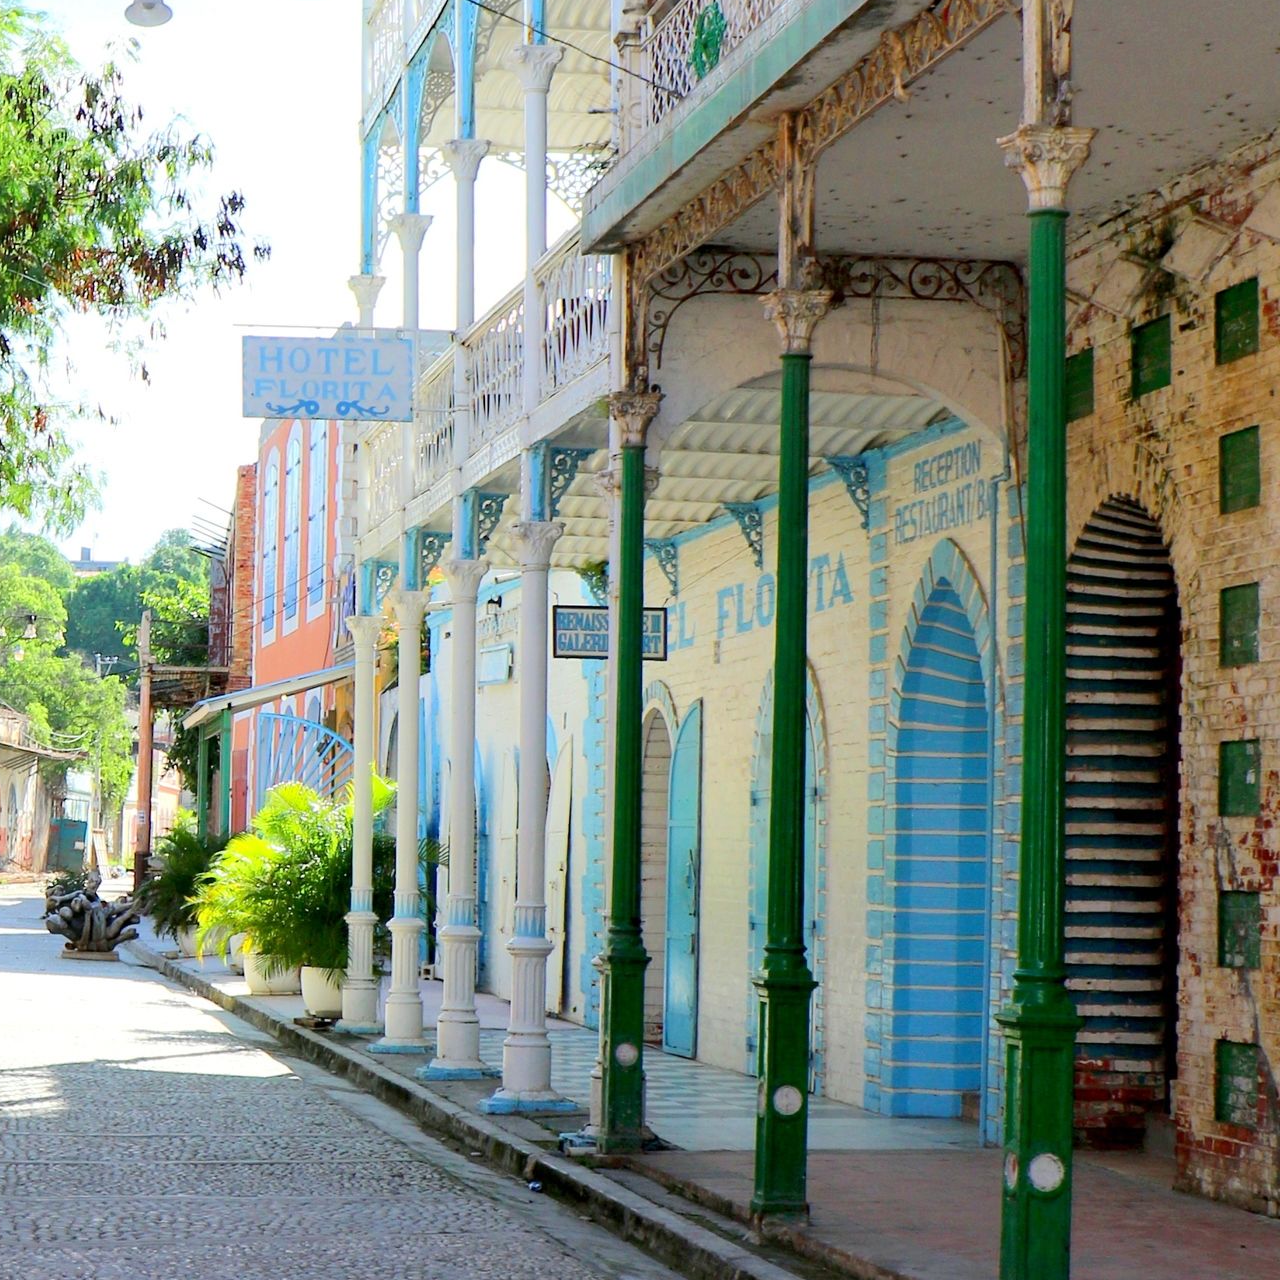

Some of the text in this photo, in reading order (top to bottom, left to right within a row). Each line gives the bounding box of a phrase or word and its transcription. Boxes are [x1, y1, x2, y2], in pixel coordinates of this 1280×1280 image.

[258, 345, 395, 376] HOTEL
[254, 378, 398, 401] FLORITA
[913, 439, 981, 495] RECEPTION
[894, 478, 992, 546] RESTAURANT/BA
[716, 551, 854, 640] FLOTA
